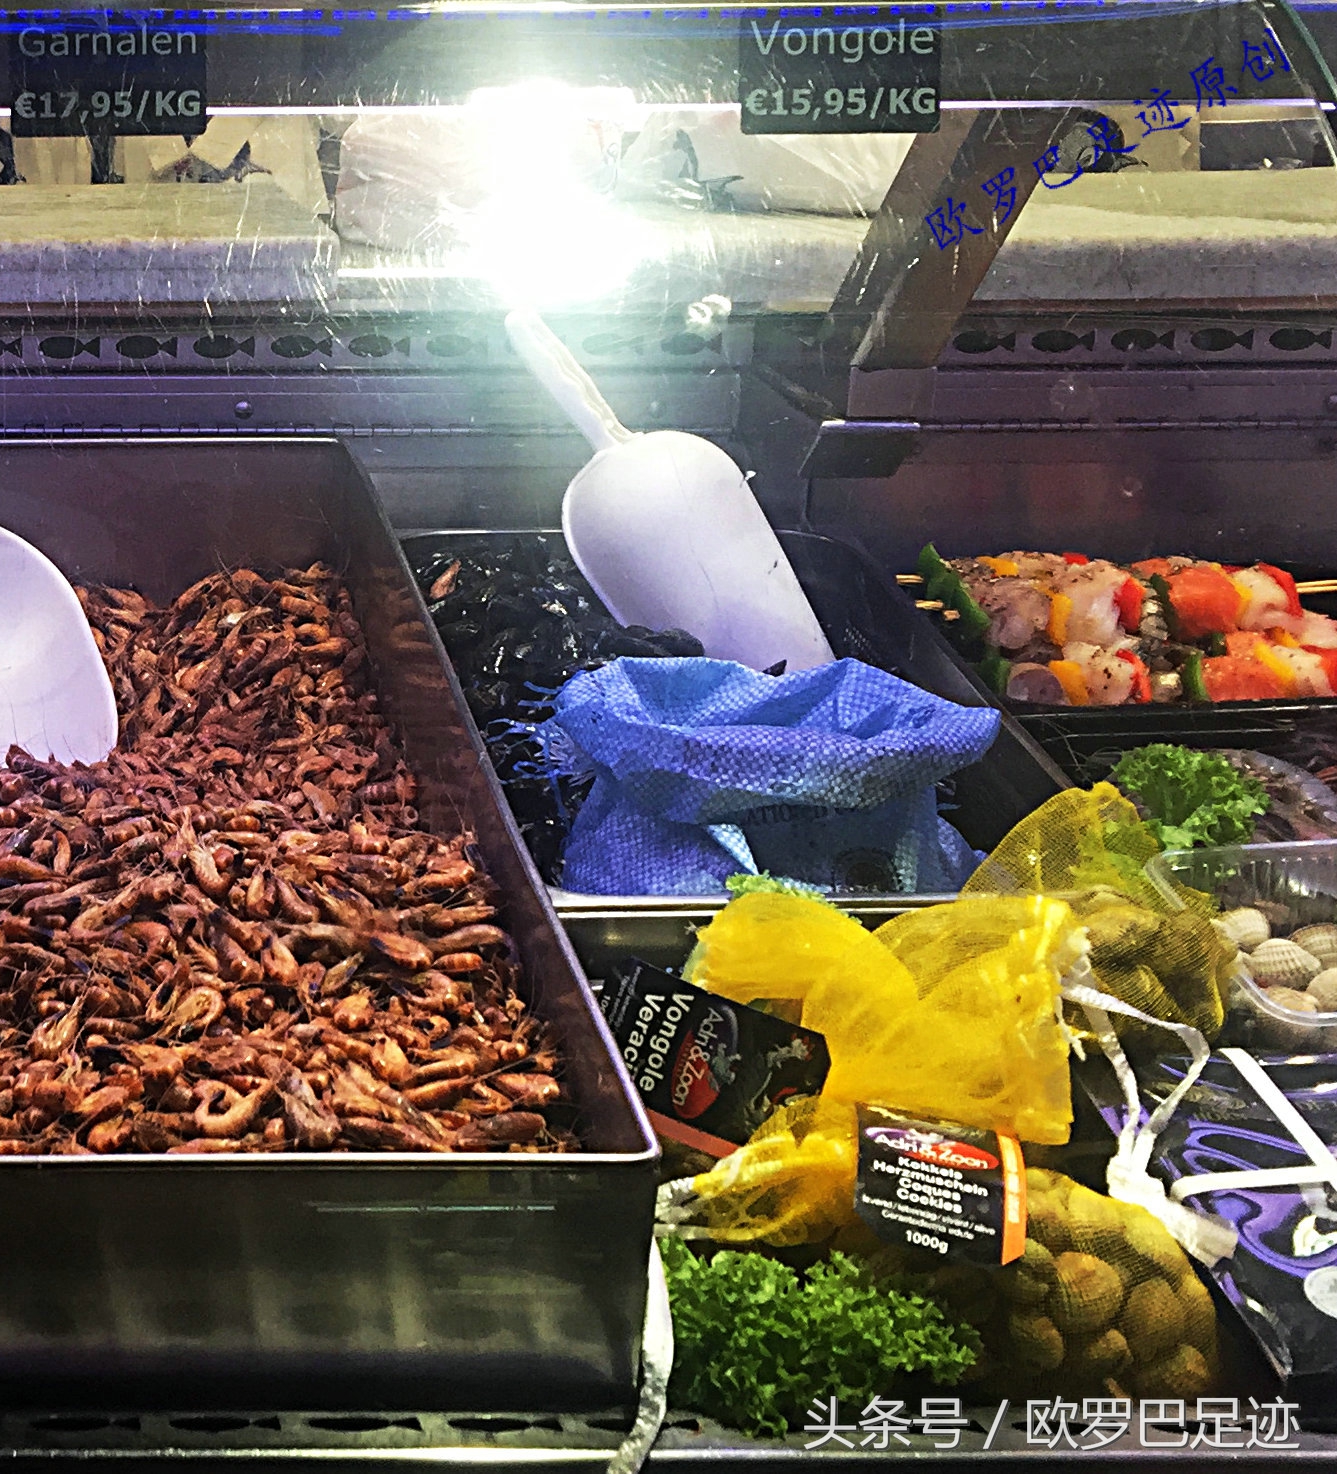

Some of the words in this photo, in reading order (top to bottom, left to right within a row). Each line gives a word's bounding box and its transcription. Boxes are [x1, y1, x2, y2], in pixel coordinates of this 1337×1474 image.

[18, 23, 197, 57] Garnalen
[751, 17, 935, 64] Vongole
[15, 90, 201, 123] €17,95/KG
[745, 87, 937, 120] €15,95/KG
[639, 992, 696, 1092] Vongole
[872, 1159, 989, 1197] Herzmuscheln
[897, 1156, 963, 1180] Kekkels
[898, 1178, 962, 1202] Coques
[905, 1229, 949, 1254] 1000g
